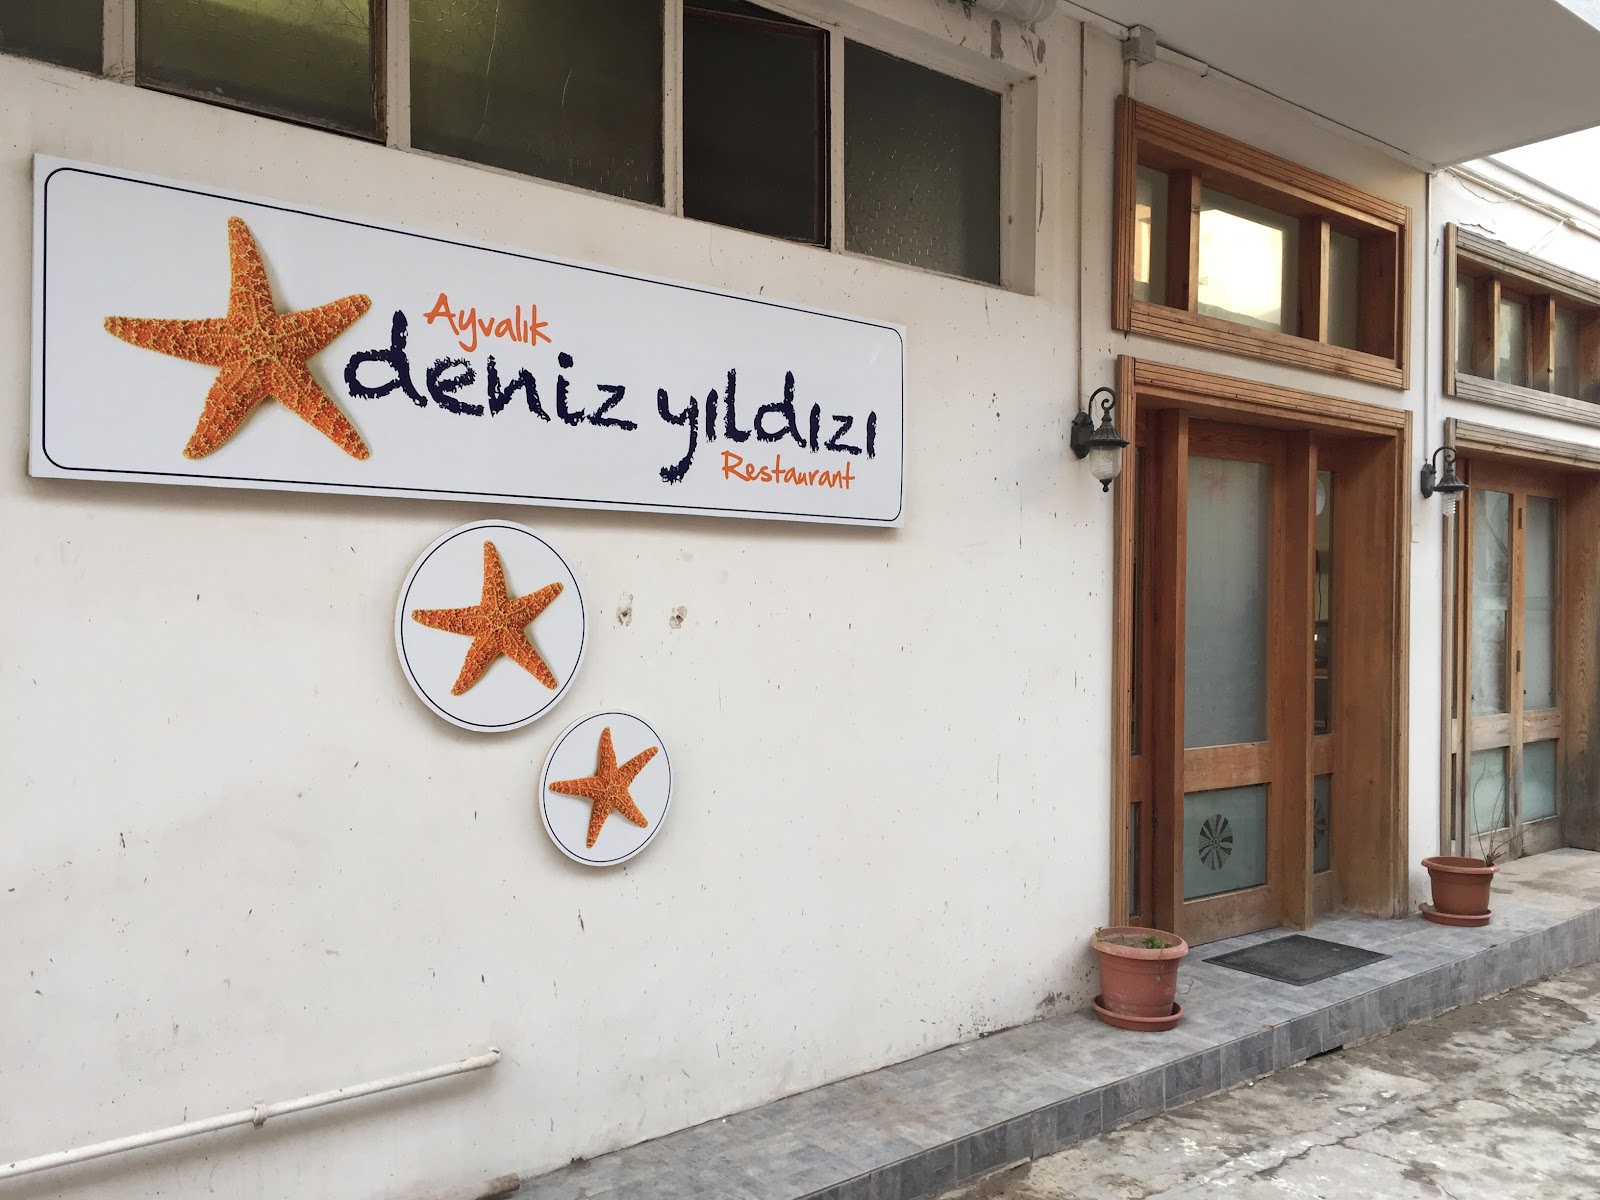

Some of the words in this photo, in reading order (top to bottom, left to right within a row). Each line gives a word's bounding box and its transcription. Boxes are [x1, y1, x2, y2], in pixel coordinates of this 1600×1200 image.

[423, 292, 552, 352] Ayvalık
[343, 309, 638, 432] deniz
[656, 368, 878, 486] yıldızı
[720, 450, 856, 490] Restaurant
